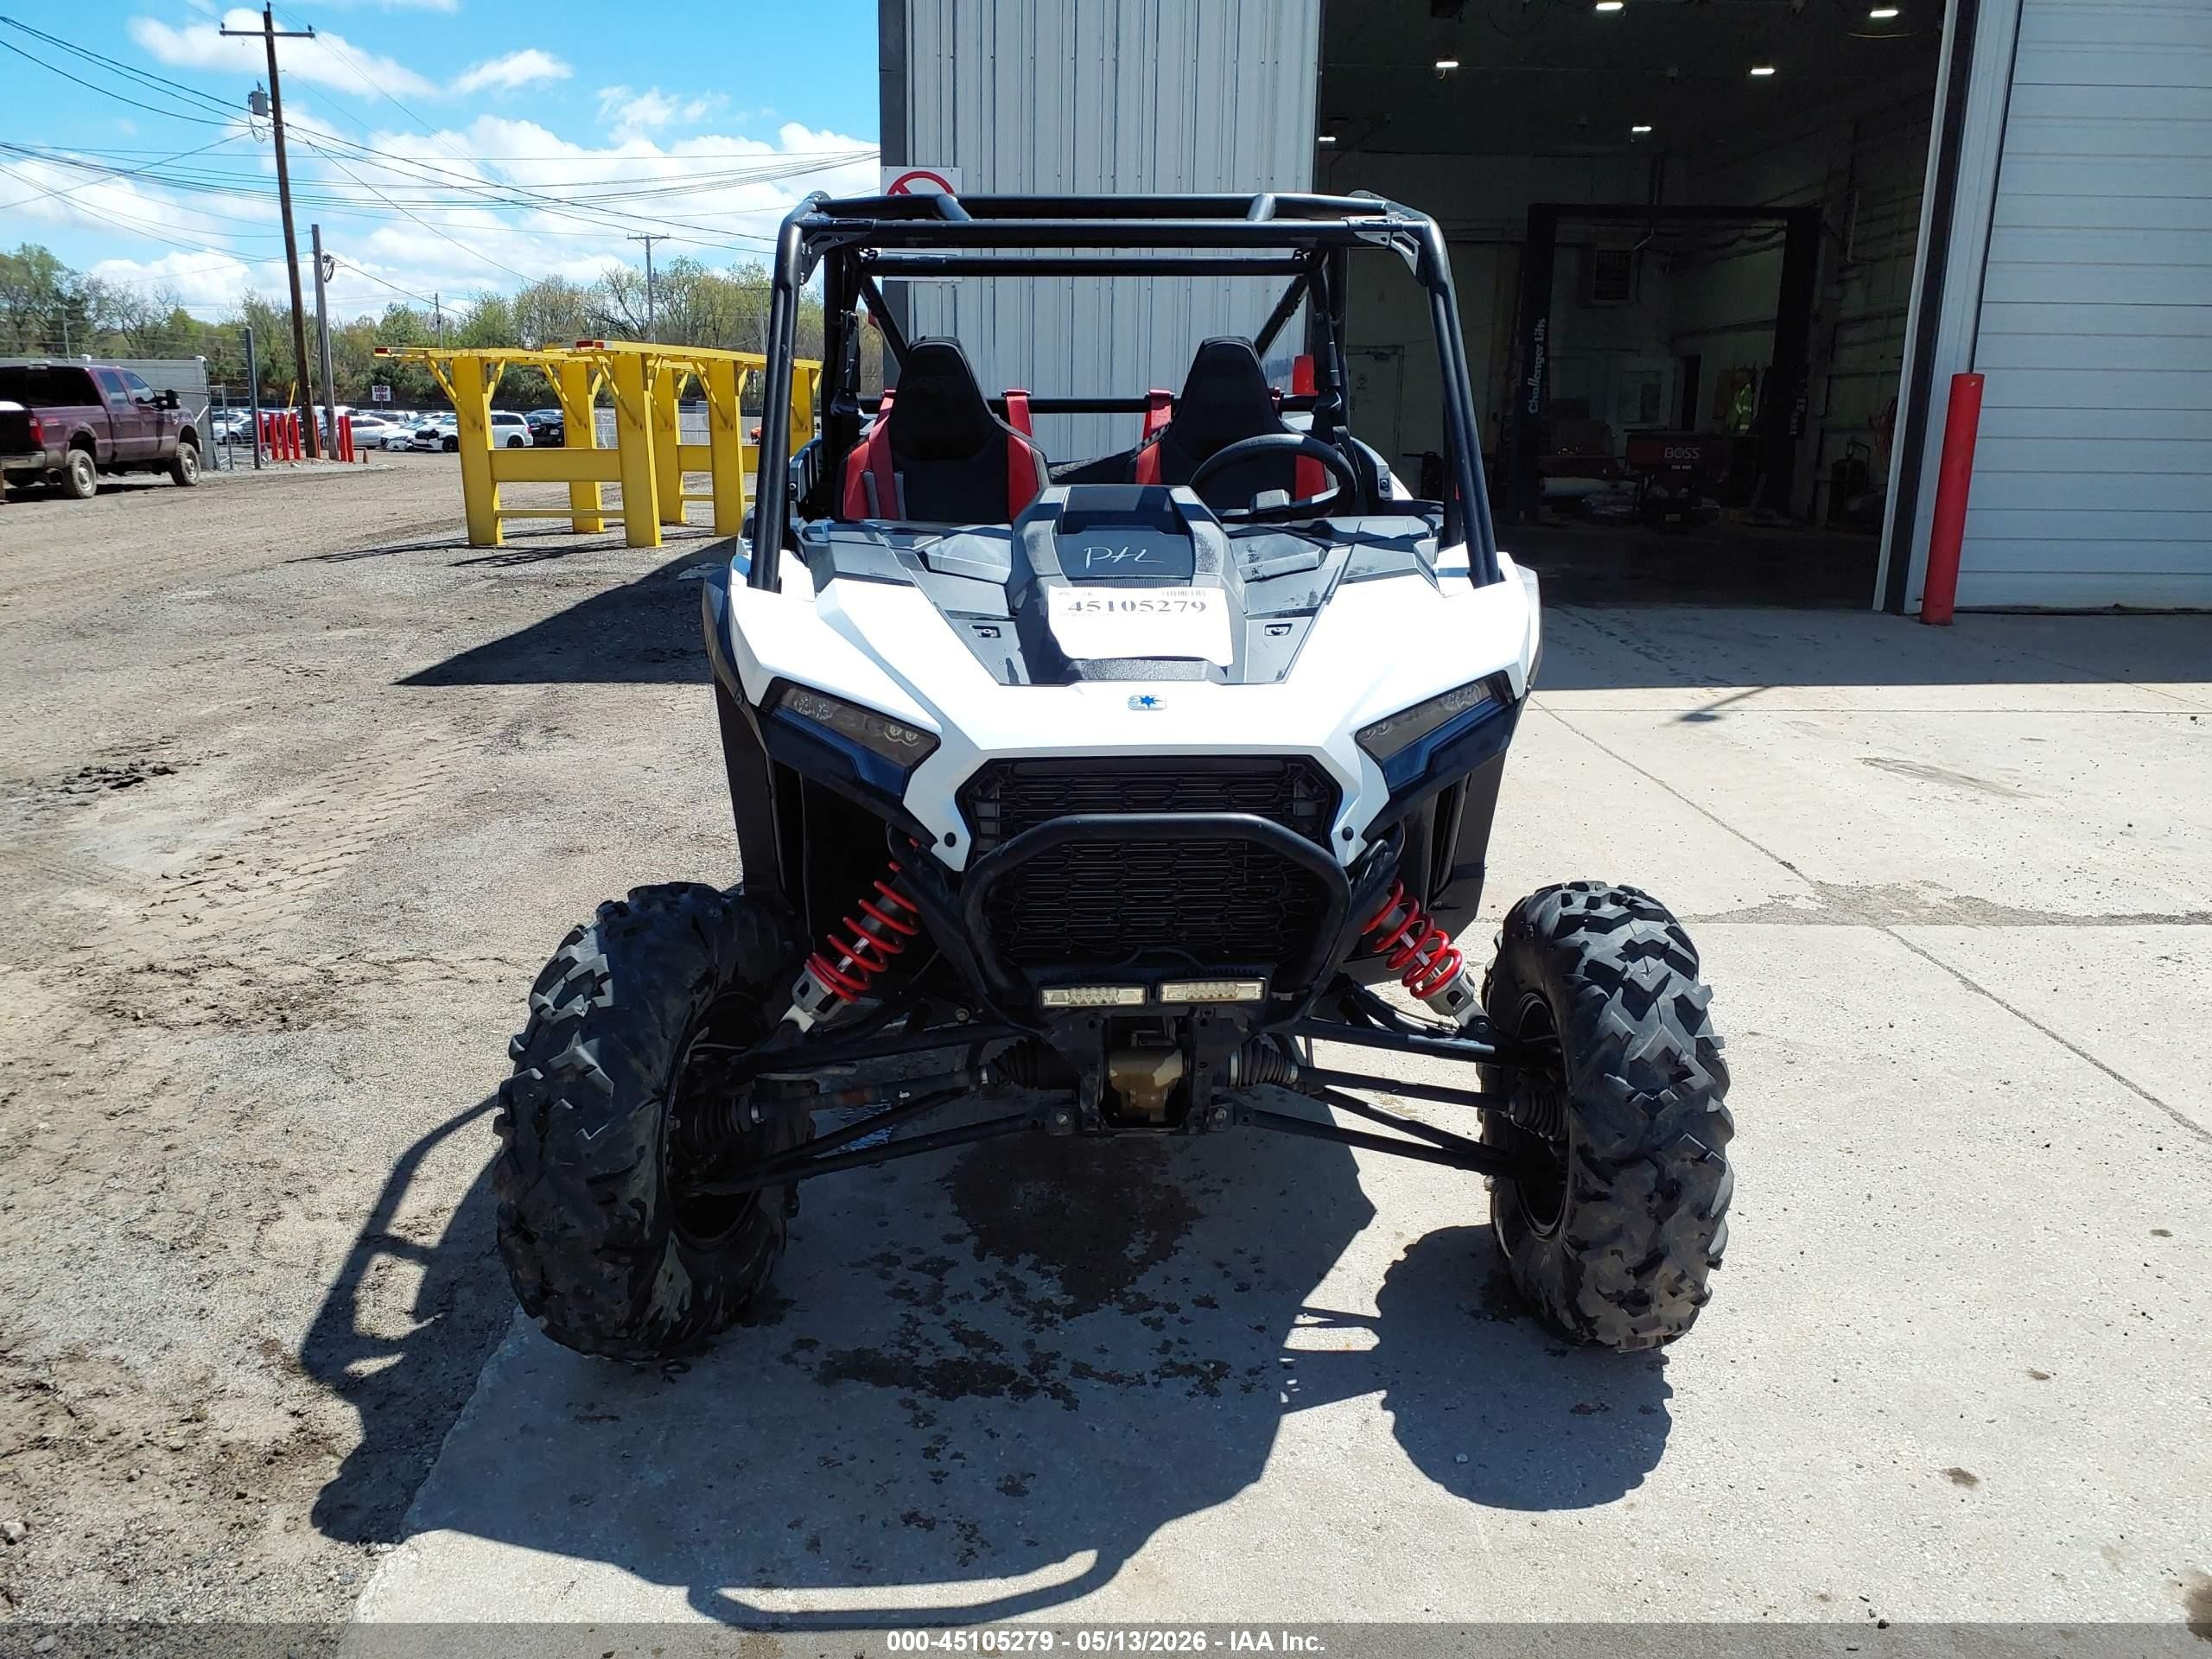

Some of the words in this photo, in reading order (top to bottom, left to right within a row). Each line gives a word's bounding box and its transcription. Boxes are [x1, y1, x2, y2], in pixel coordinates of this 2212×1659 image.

[1535, 318, 1546, 342] Lifts
[1528, 344, 1545, 414] Challenger
[1664, 447, 1700, 459] BOSS
[1067, 600, 1207, 613] 45105279
